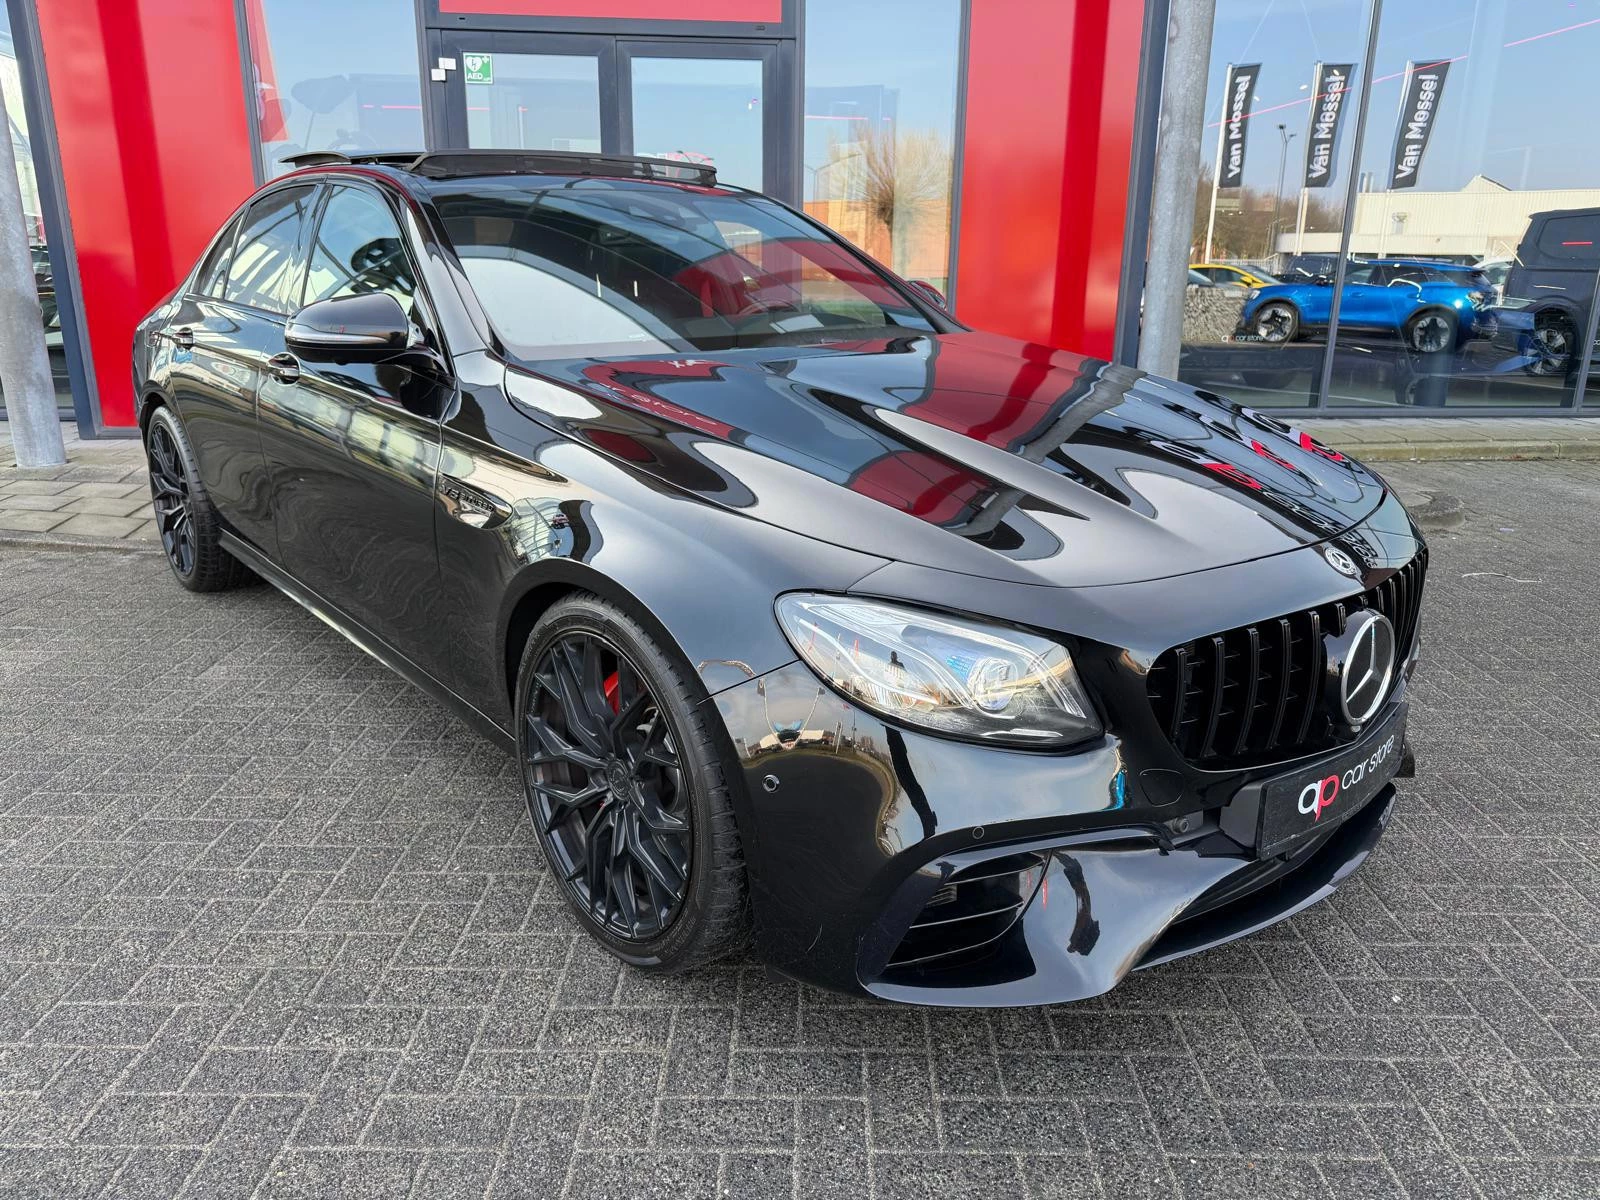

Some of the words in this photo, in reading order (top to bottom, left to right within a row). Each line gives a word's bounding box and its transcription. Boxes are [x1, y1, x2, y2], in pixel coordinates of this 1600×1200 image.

[467, 72, 483, 80] AED
[1229, 75, 1251, 140] Mossel
[1313, 74, 1346, 139] Mossel
[1405, 74, 1439, 139] Mossel
[1227, 143, 1242, 178] Van
[1308, 143, 1331, 178] Van
[1395, 144, 1421, 179] Van
[1341, 759, 1369, 790] car
[1368, 735, 1394, 773] store
